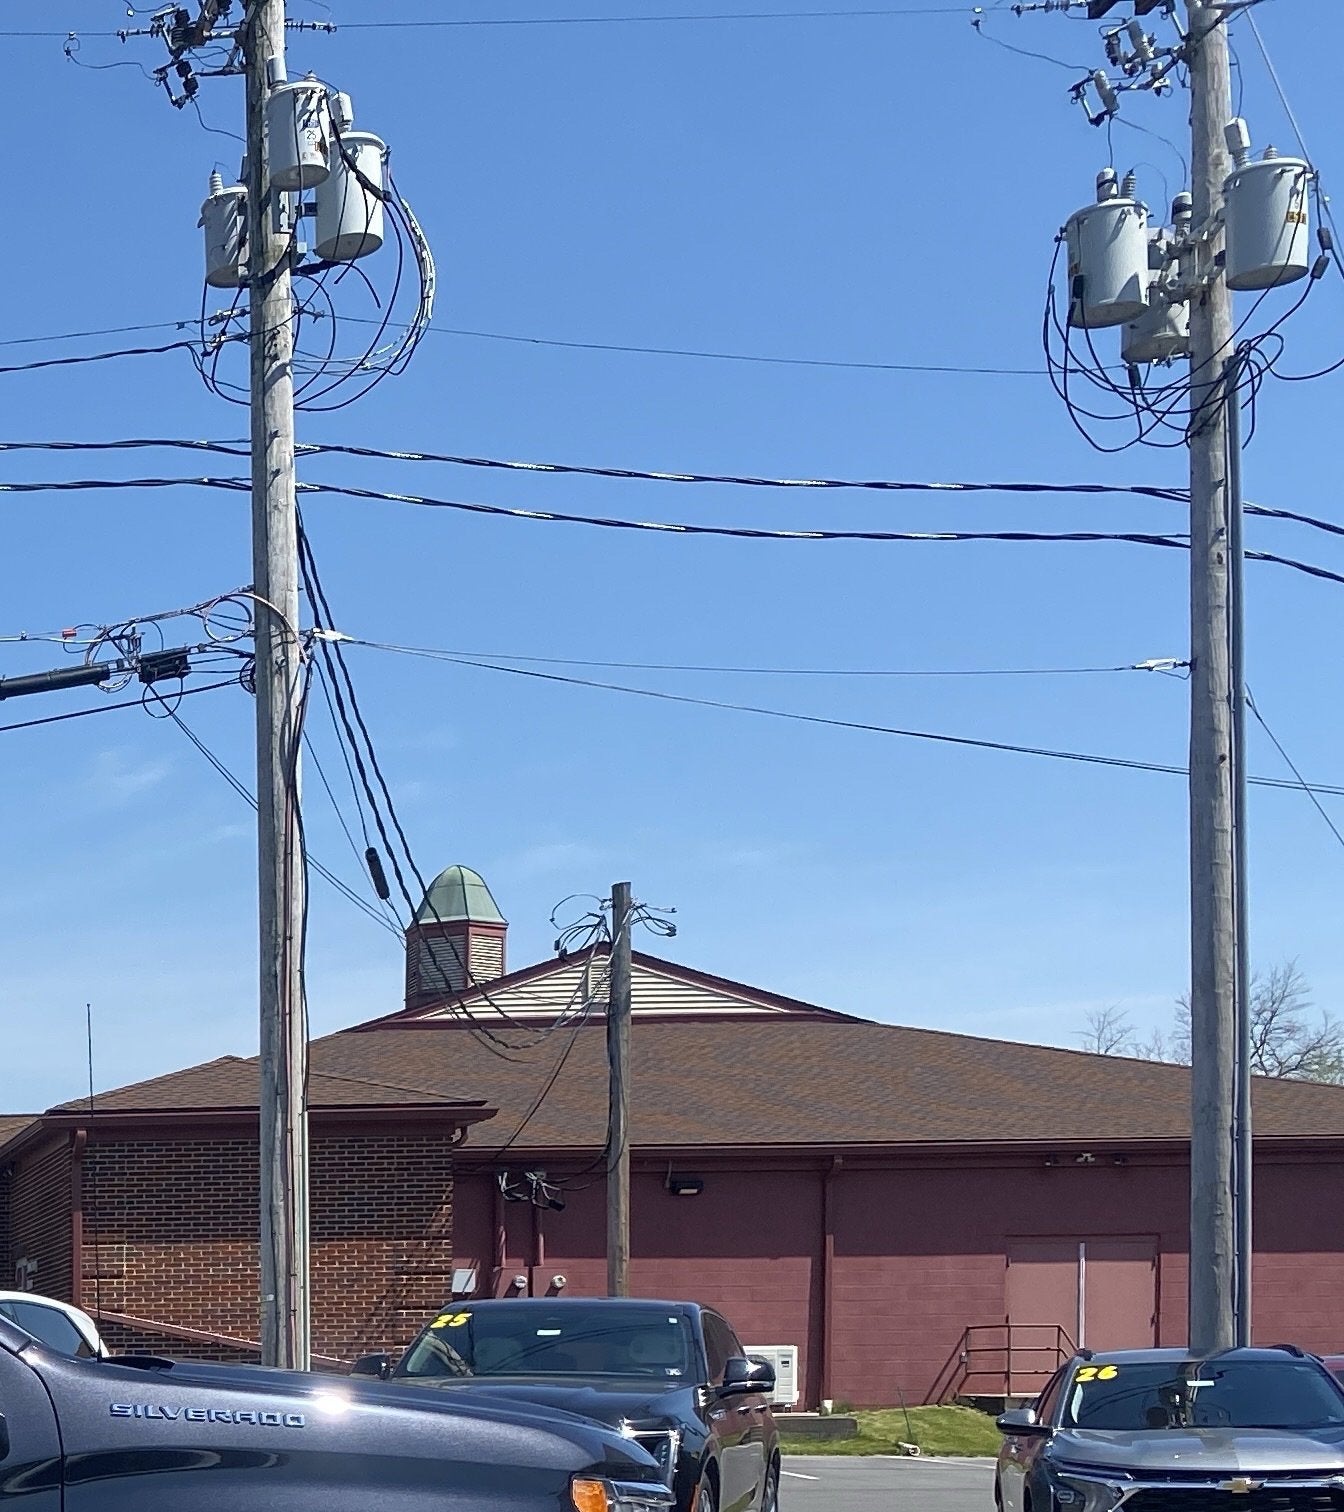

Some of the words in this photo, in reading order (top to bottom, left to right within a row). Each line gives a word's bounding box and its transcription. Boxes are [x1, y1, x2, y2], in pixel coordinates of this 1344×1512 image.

[429, 1312, 473, 1329] 25
[1074, 1365, 1119, 1383] 26
[110, 1403, 306, 1428] SILVERADO
